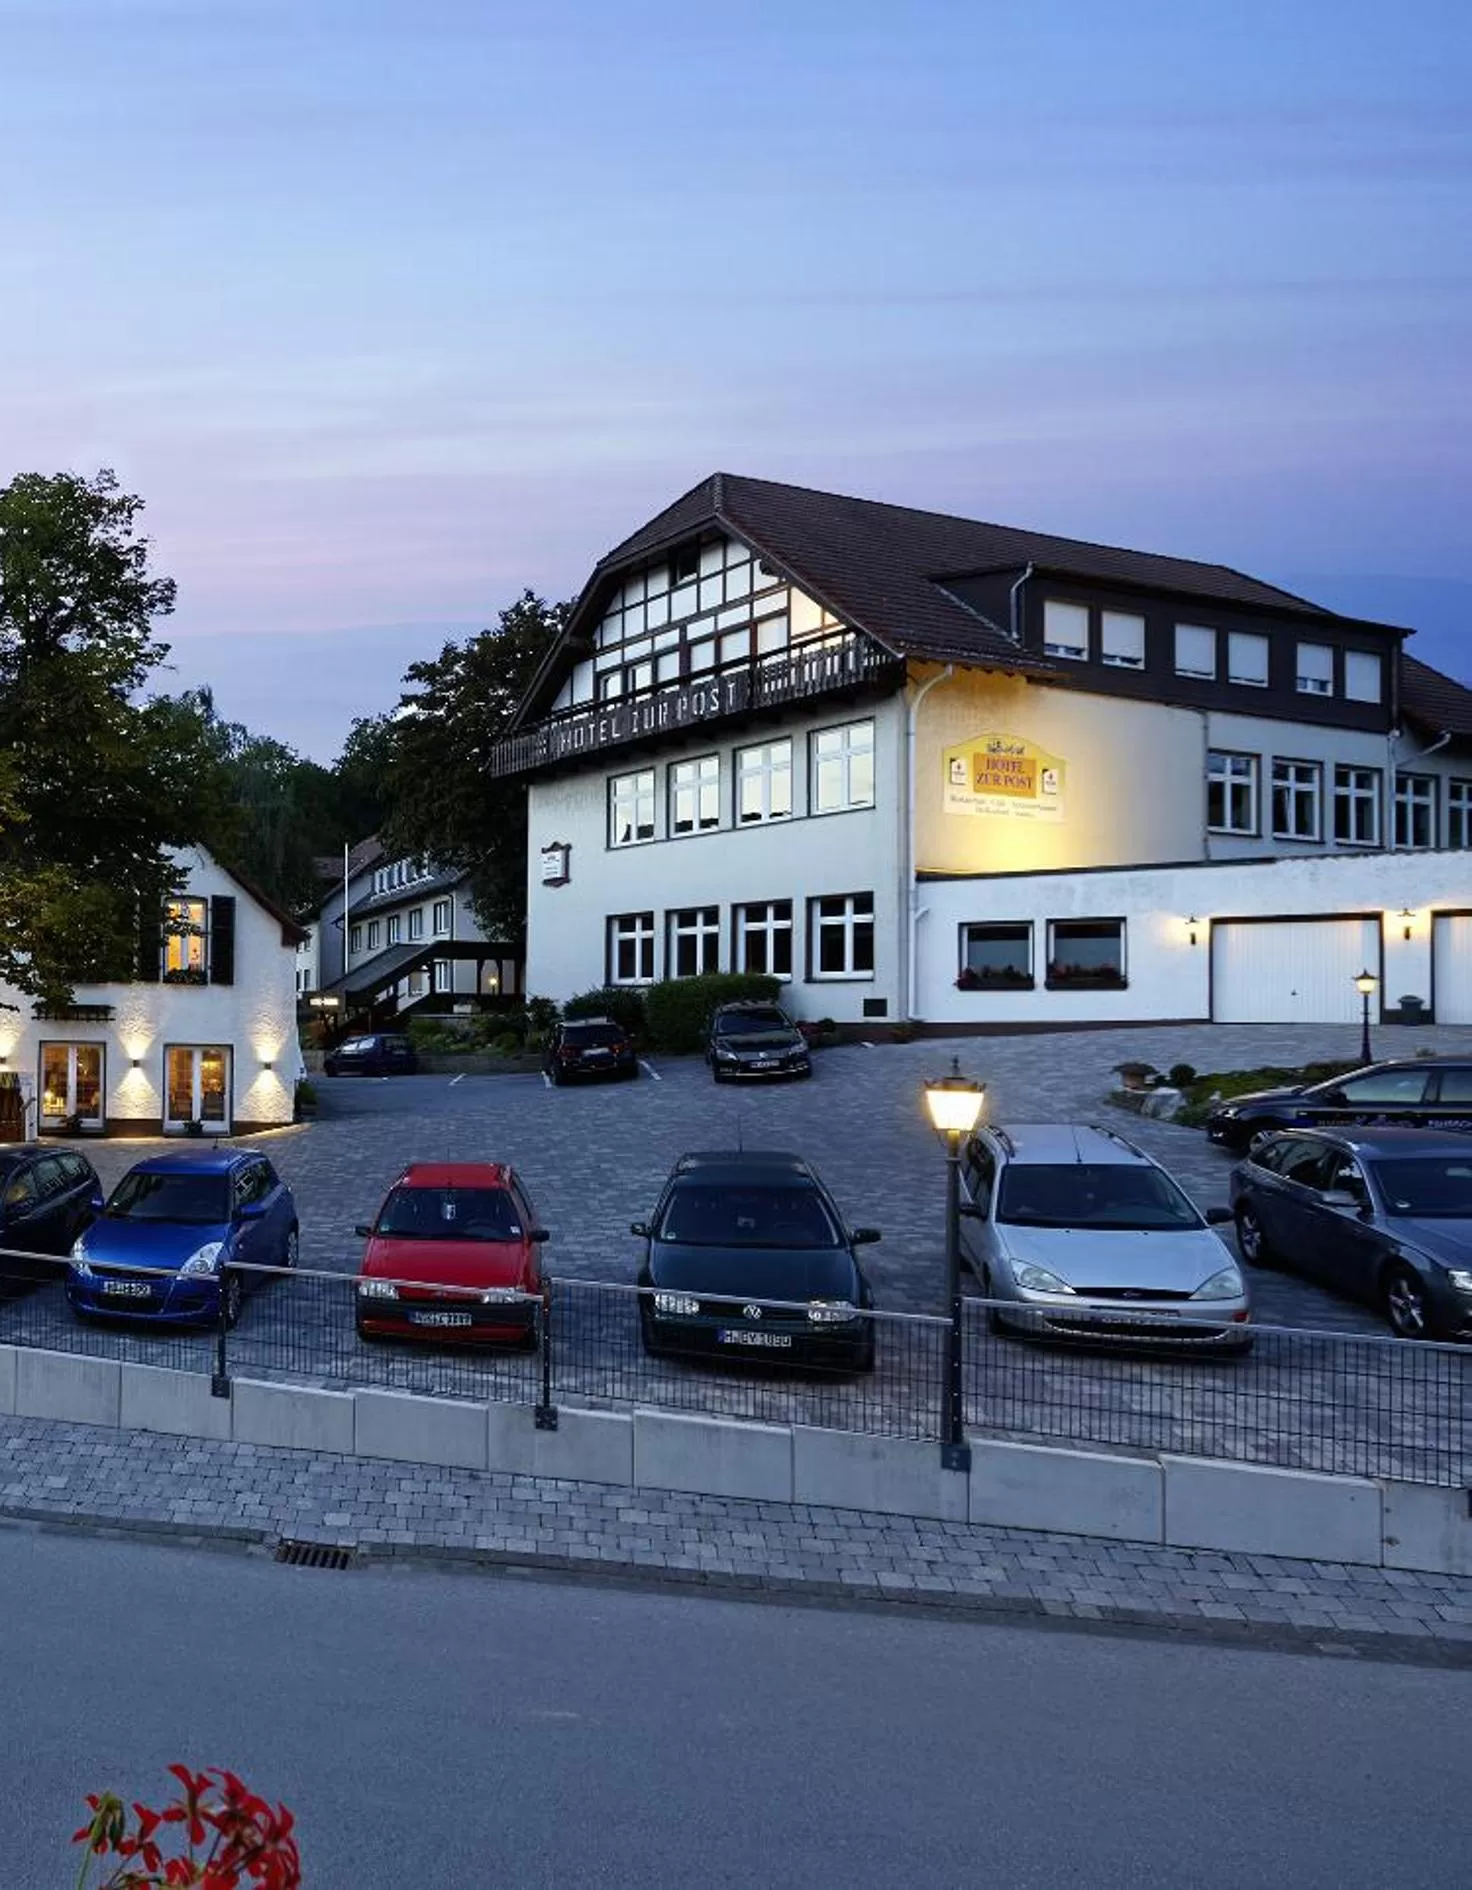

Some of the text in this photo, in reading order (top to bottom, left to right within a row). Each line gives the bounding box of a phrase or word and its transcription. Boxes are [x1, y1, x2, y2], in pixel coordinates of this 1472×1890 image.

[559, 681, 736, 753] HOTEL ZUR POST
[985, 757, 1025, 774] HOTEL
[975, 772, 1002, 786] ZUR
[1003, 775, 1032, 790] POST
